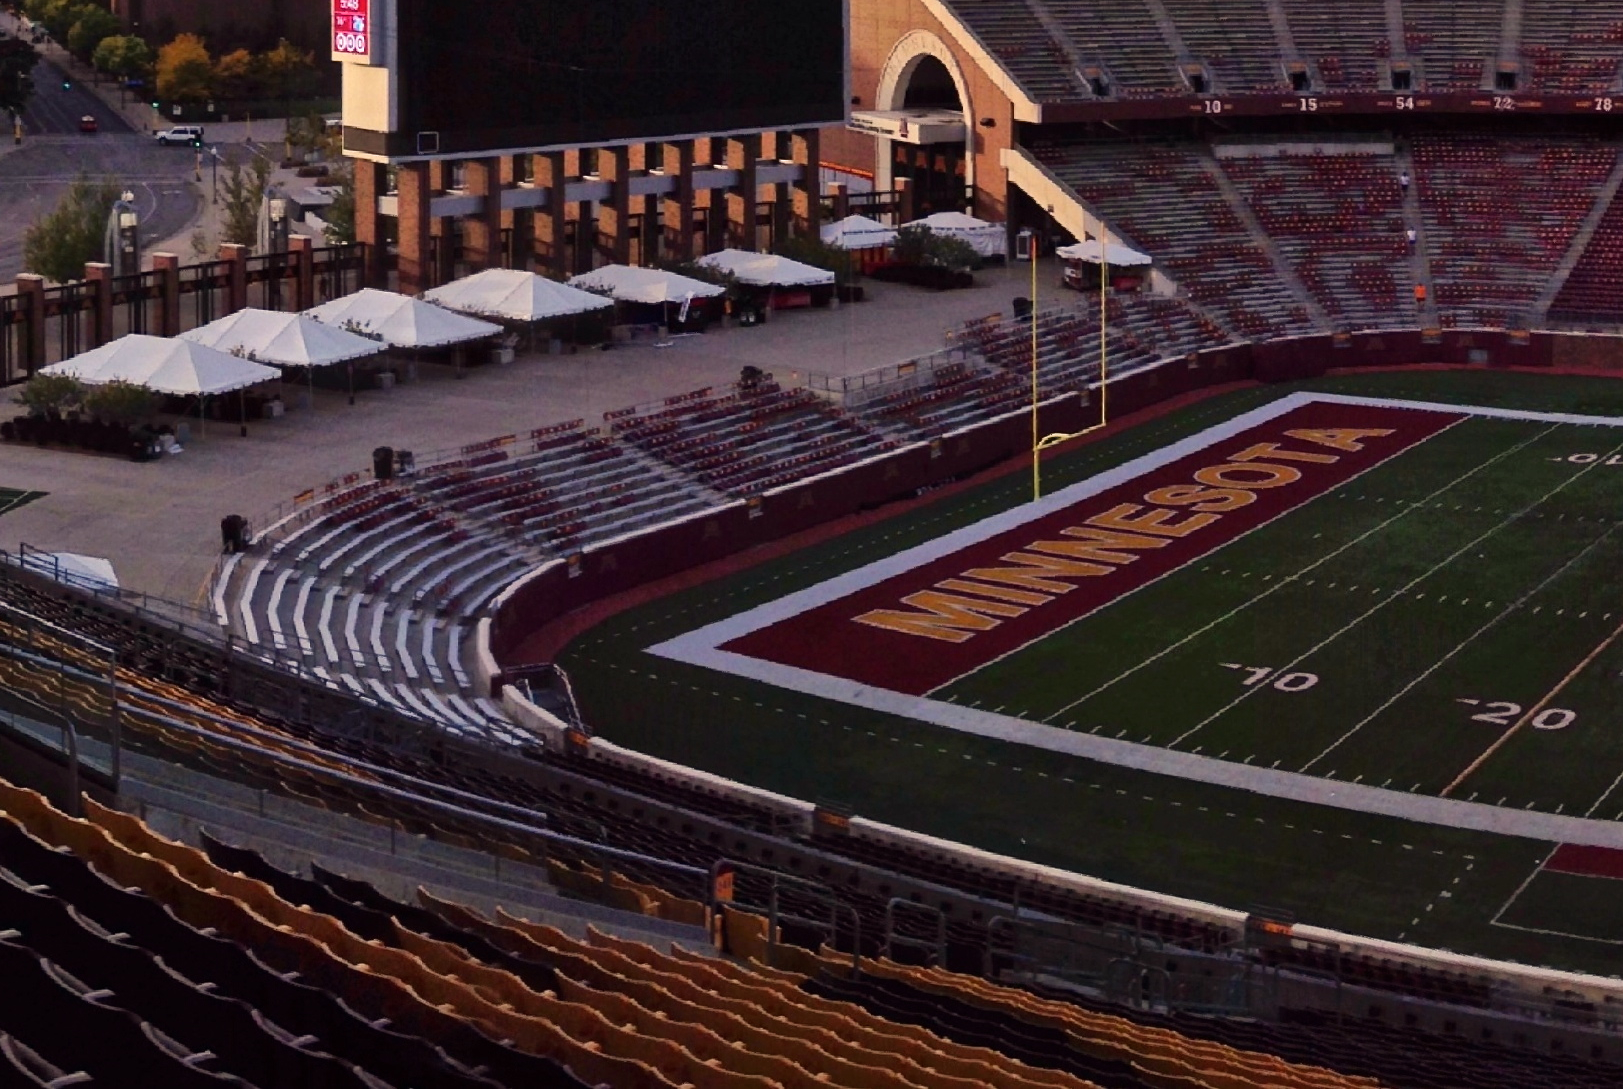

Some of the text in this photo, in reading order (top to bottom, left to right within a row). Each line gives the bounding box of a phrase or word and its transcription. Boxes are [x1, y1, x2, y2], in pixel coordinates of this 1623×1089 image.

[1204, 100, 1221, 113] 10
[1300, 98, 1317, 111] 15
[1396, 97, 1414, 110] 54
[1595, 97, 1612, 112] 78
[851, 427, 1397, 643] MINNESOTA
[1242, 665, 1320, 693] 10
[1471, 699, 1576, 730] 20
